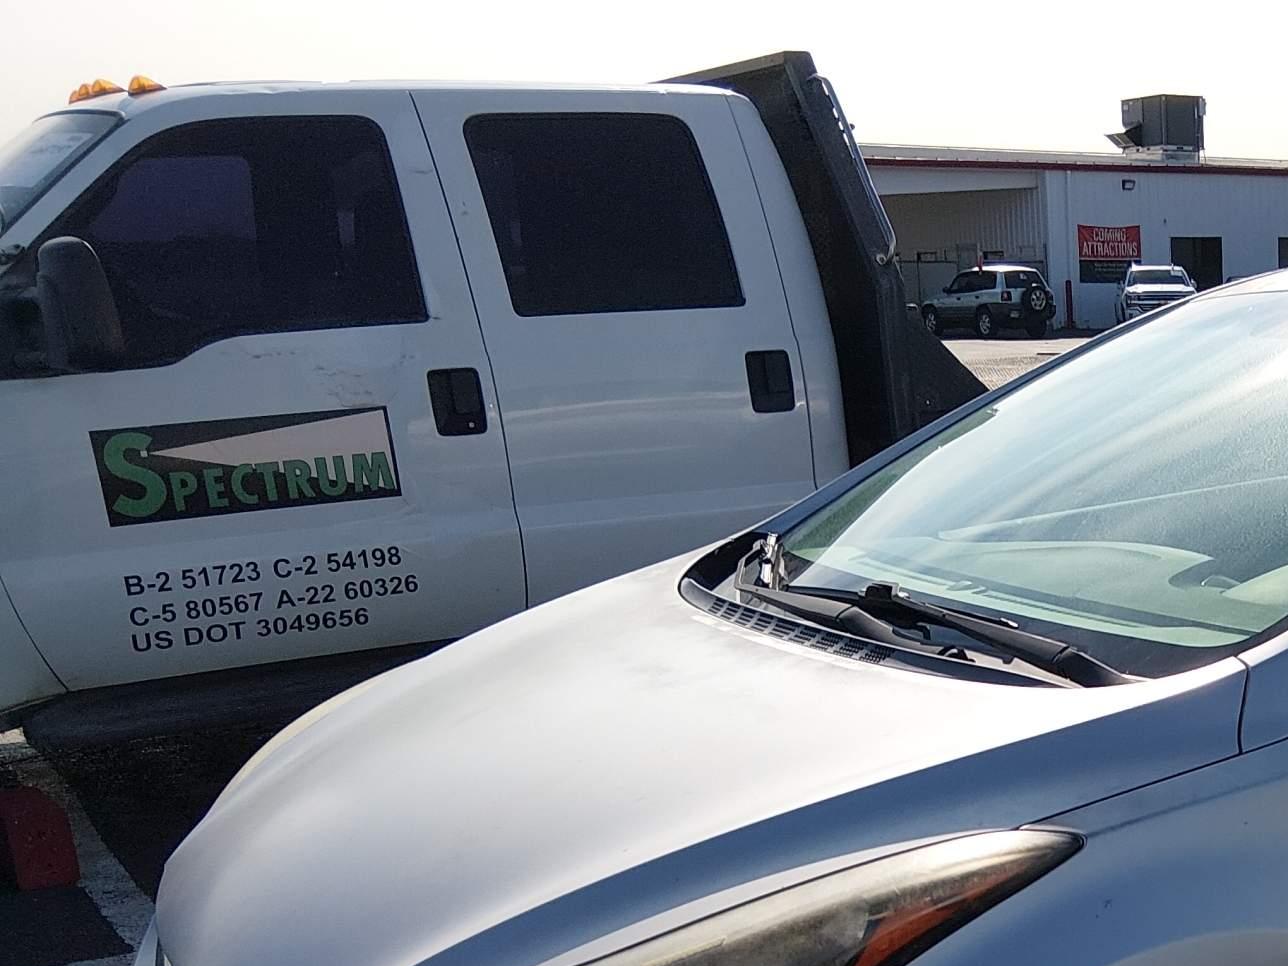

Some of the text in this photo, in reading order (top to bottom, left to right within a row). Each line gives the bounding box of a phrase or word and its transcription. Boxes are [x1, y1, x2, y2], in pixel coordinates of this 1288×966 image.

[1082, 241, 1138, 256] ATTRACTIONS
[1093, 228, 1127, 241] COMING
[103, 432, 397, 517] SPECTRUM
[123, 546, 402, 596] B-2 51723 C-2 54198
[129, 574, 419, 627] C-5 80567 A-22 60326
[131, 607, 369, 652] US DOT 3049656
